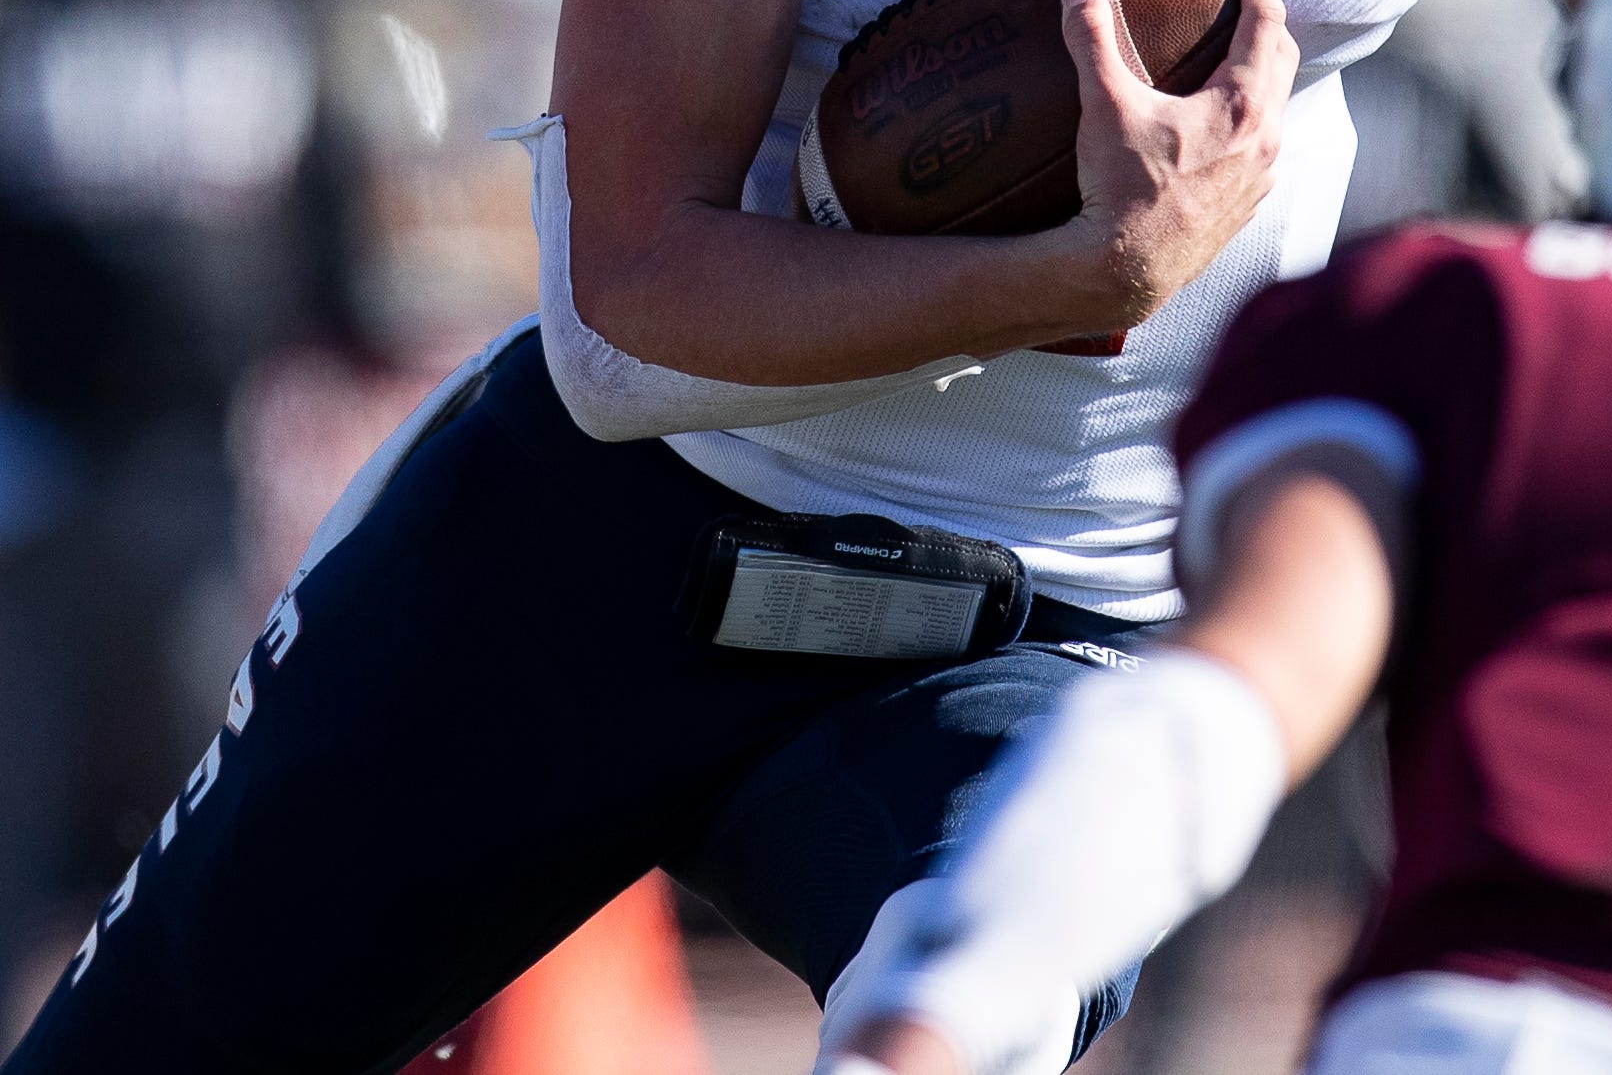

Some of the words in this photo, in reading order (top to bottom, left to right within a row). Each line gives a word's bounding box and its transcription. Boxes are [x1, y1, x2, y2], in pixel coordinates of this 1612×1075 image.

[849, 16, 1010, 119] Wilson
[908, 103, 1004, 182] GST
[834, 542, 889, 558] CHAMPRO
